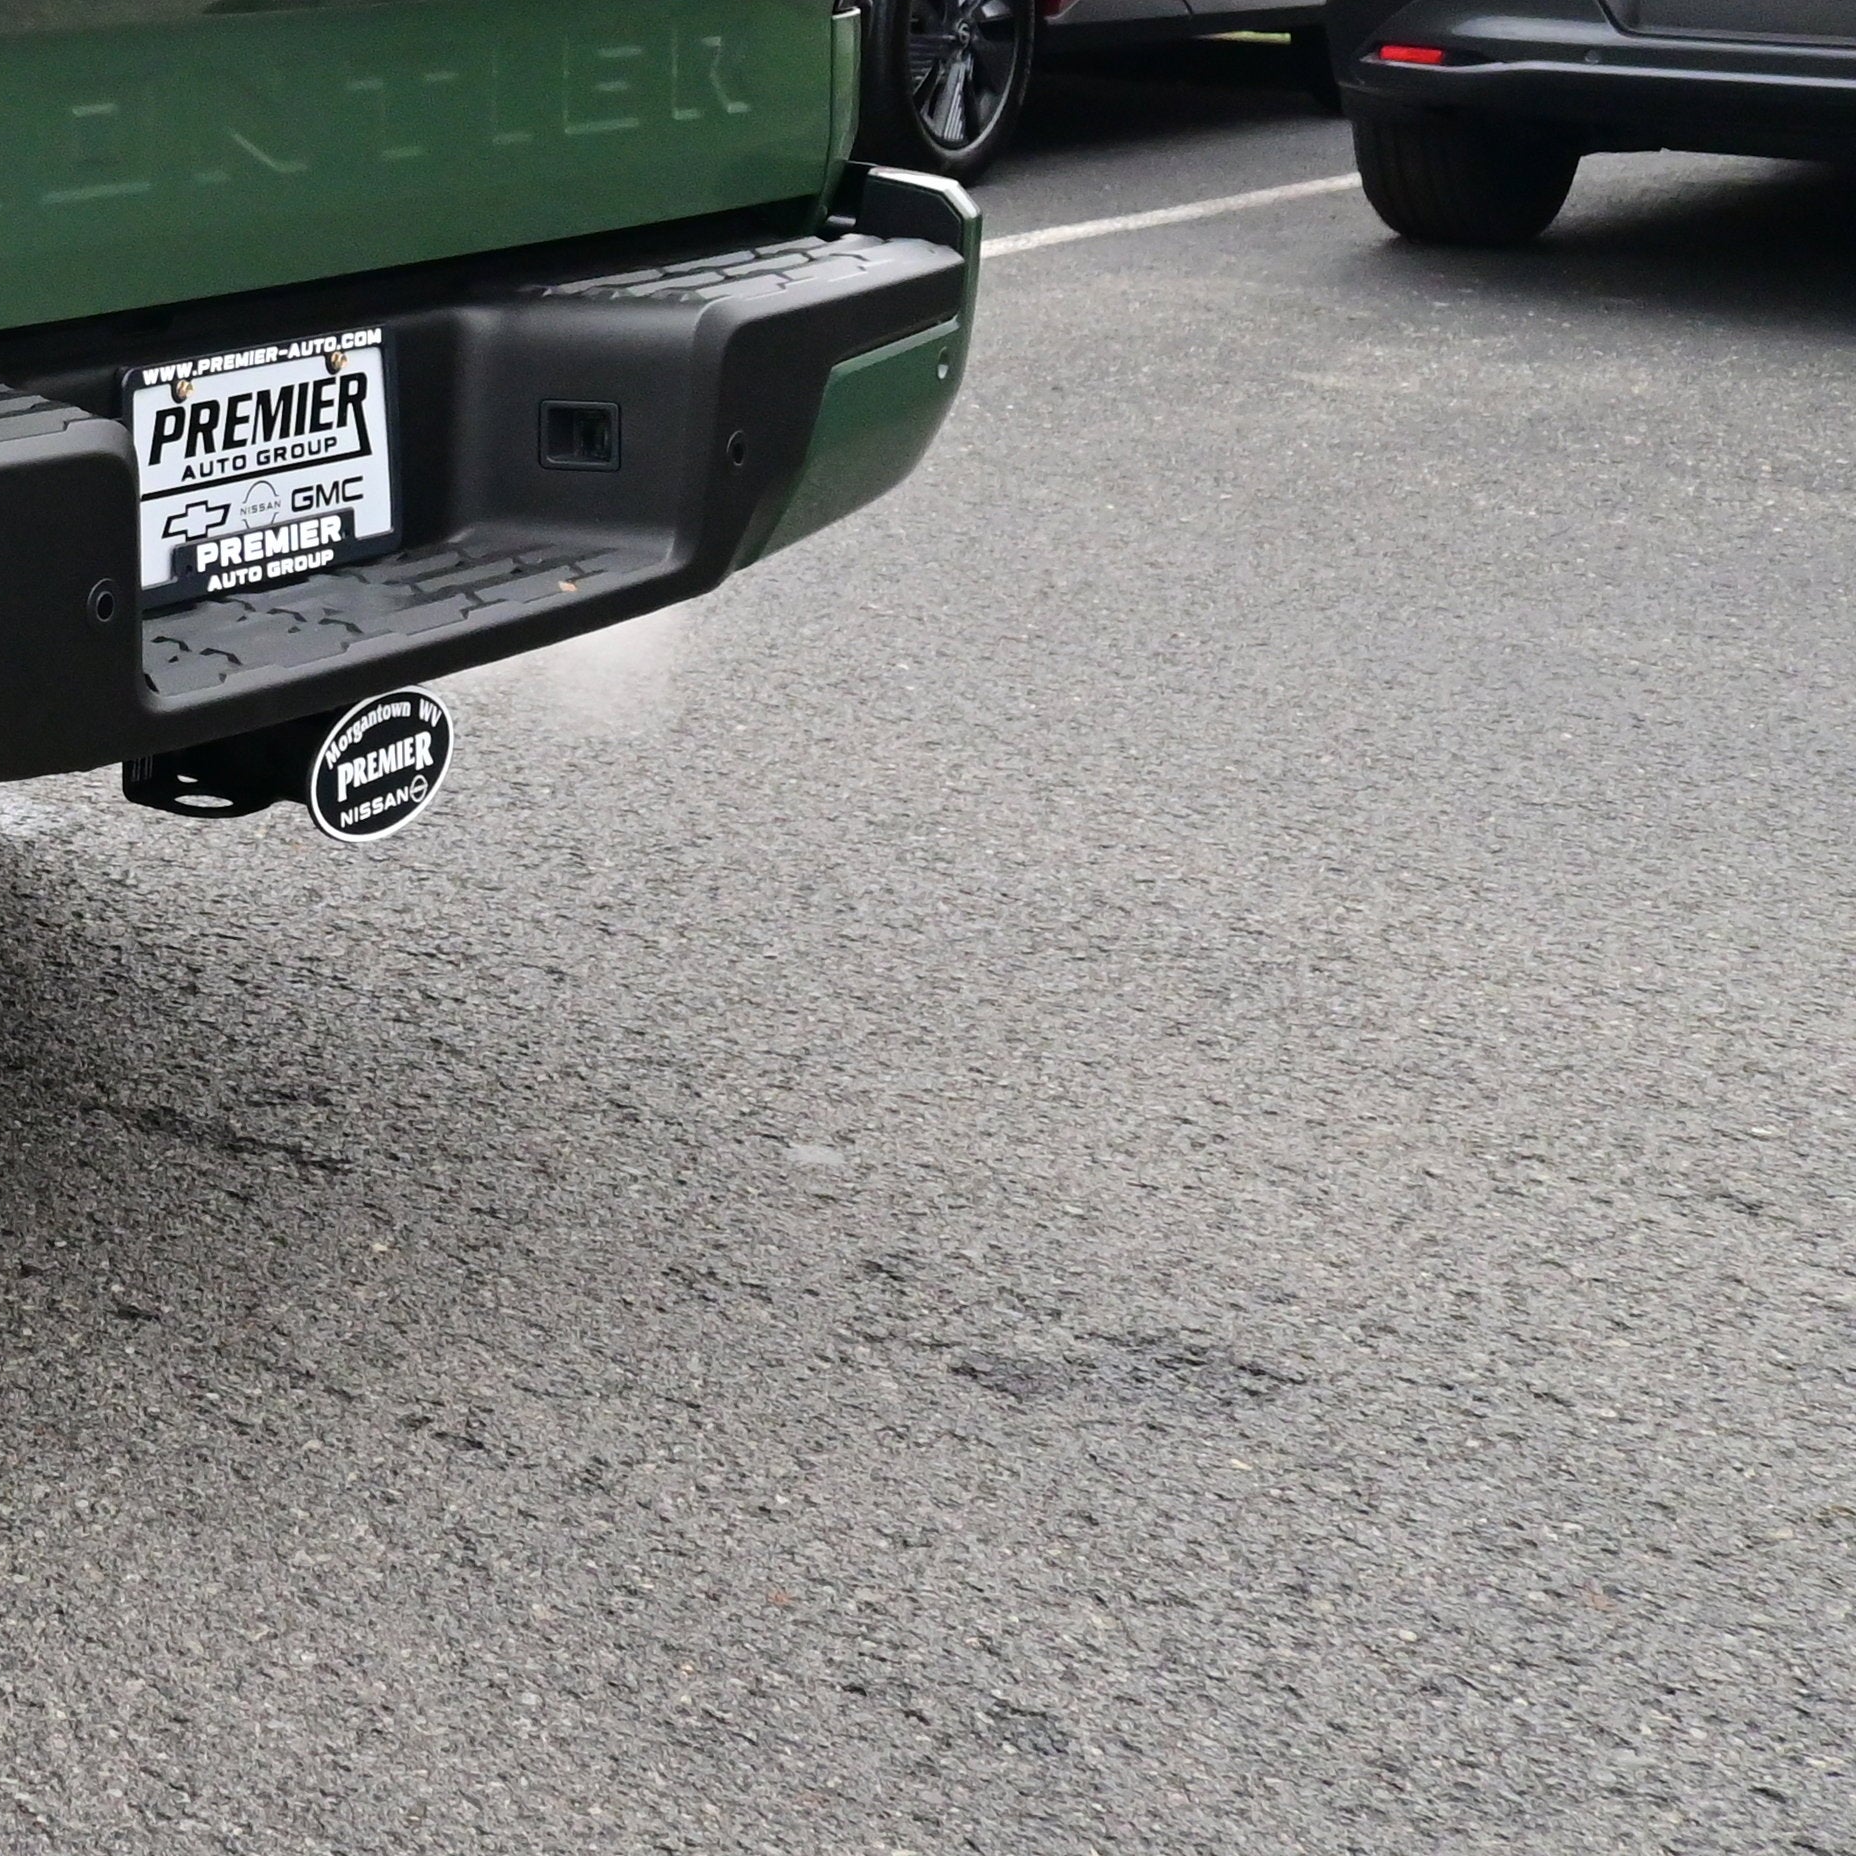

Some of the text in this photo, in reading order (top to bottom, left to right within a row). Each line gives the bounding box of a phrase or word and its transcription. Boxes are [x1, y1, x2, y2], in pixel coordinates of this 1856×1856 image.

[142, 327, 383, 386] WWW.PREMIER-AUTO.COM
[148, 372, 373, 466] PREMIER
[181, 436, 337, 482] AUTO GROUP
[240, 476, 364, 516] NISSAN GMC
[196, 515, 342, 573] PREMIER
[207, 549, 334, 592] AUTO GROUP
[324, 698, 442, 770] Morgantown WV
[337, 731, 434, 803] PREMIER
[340, 786, 409, 828] NISSAN
